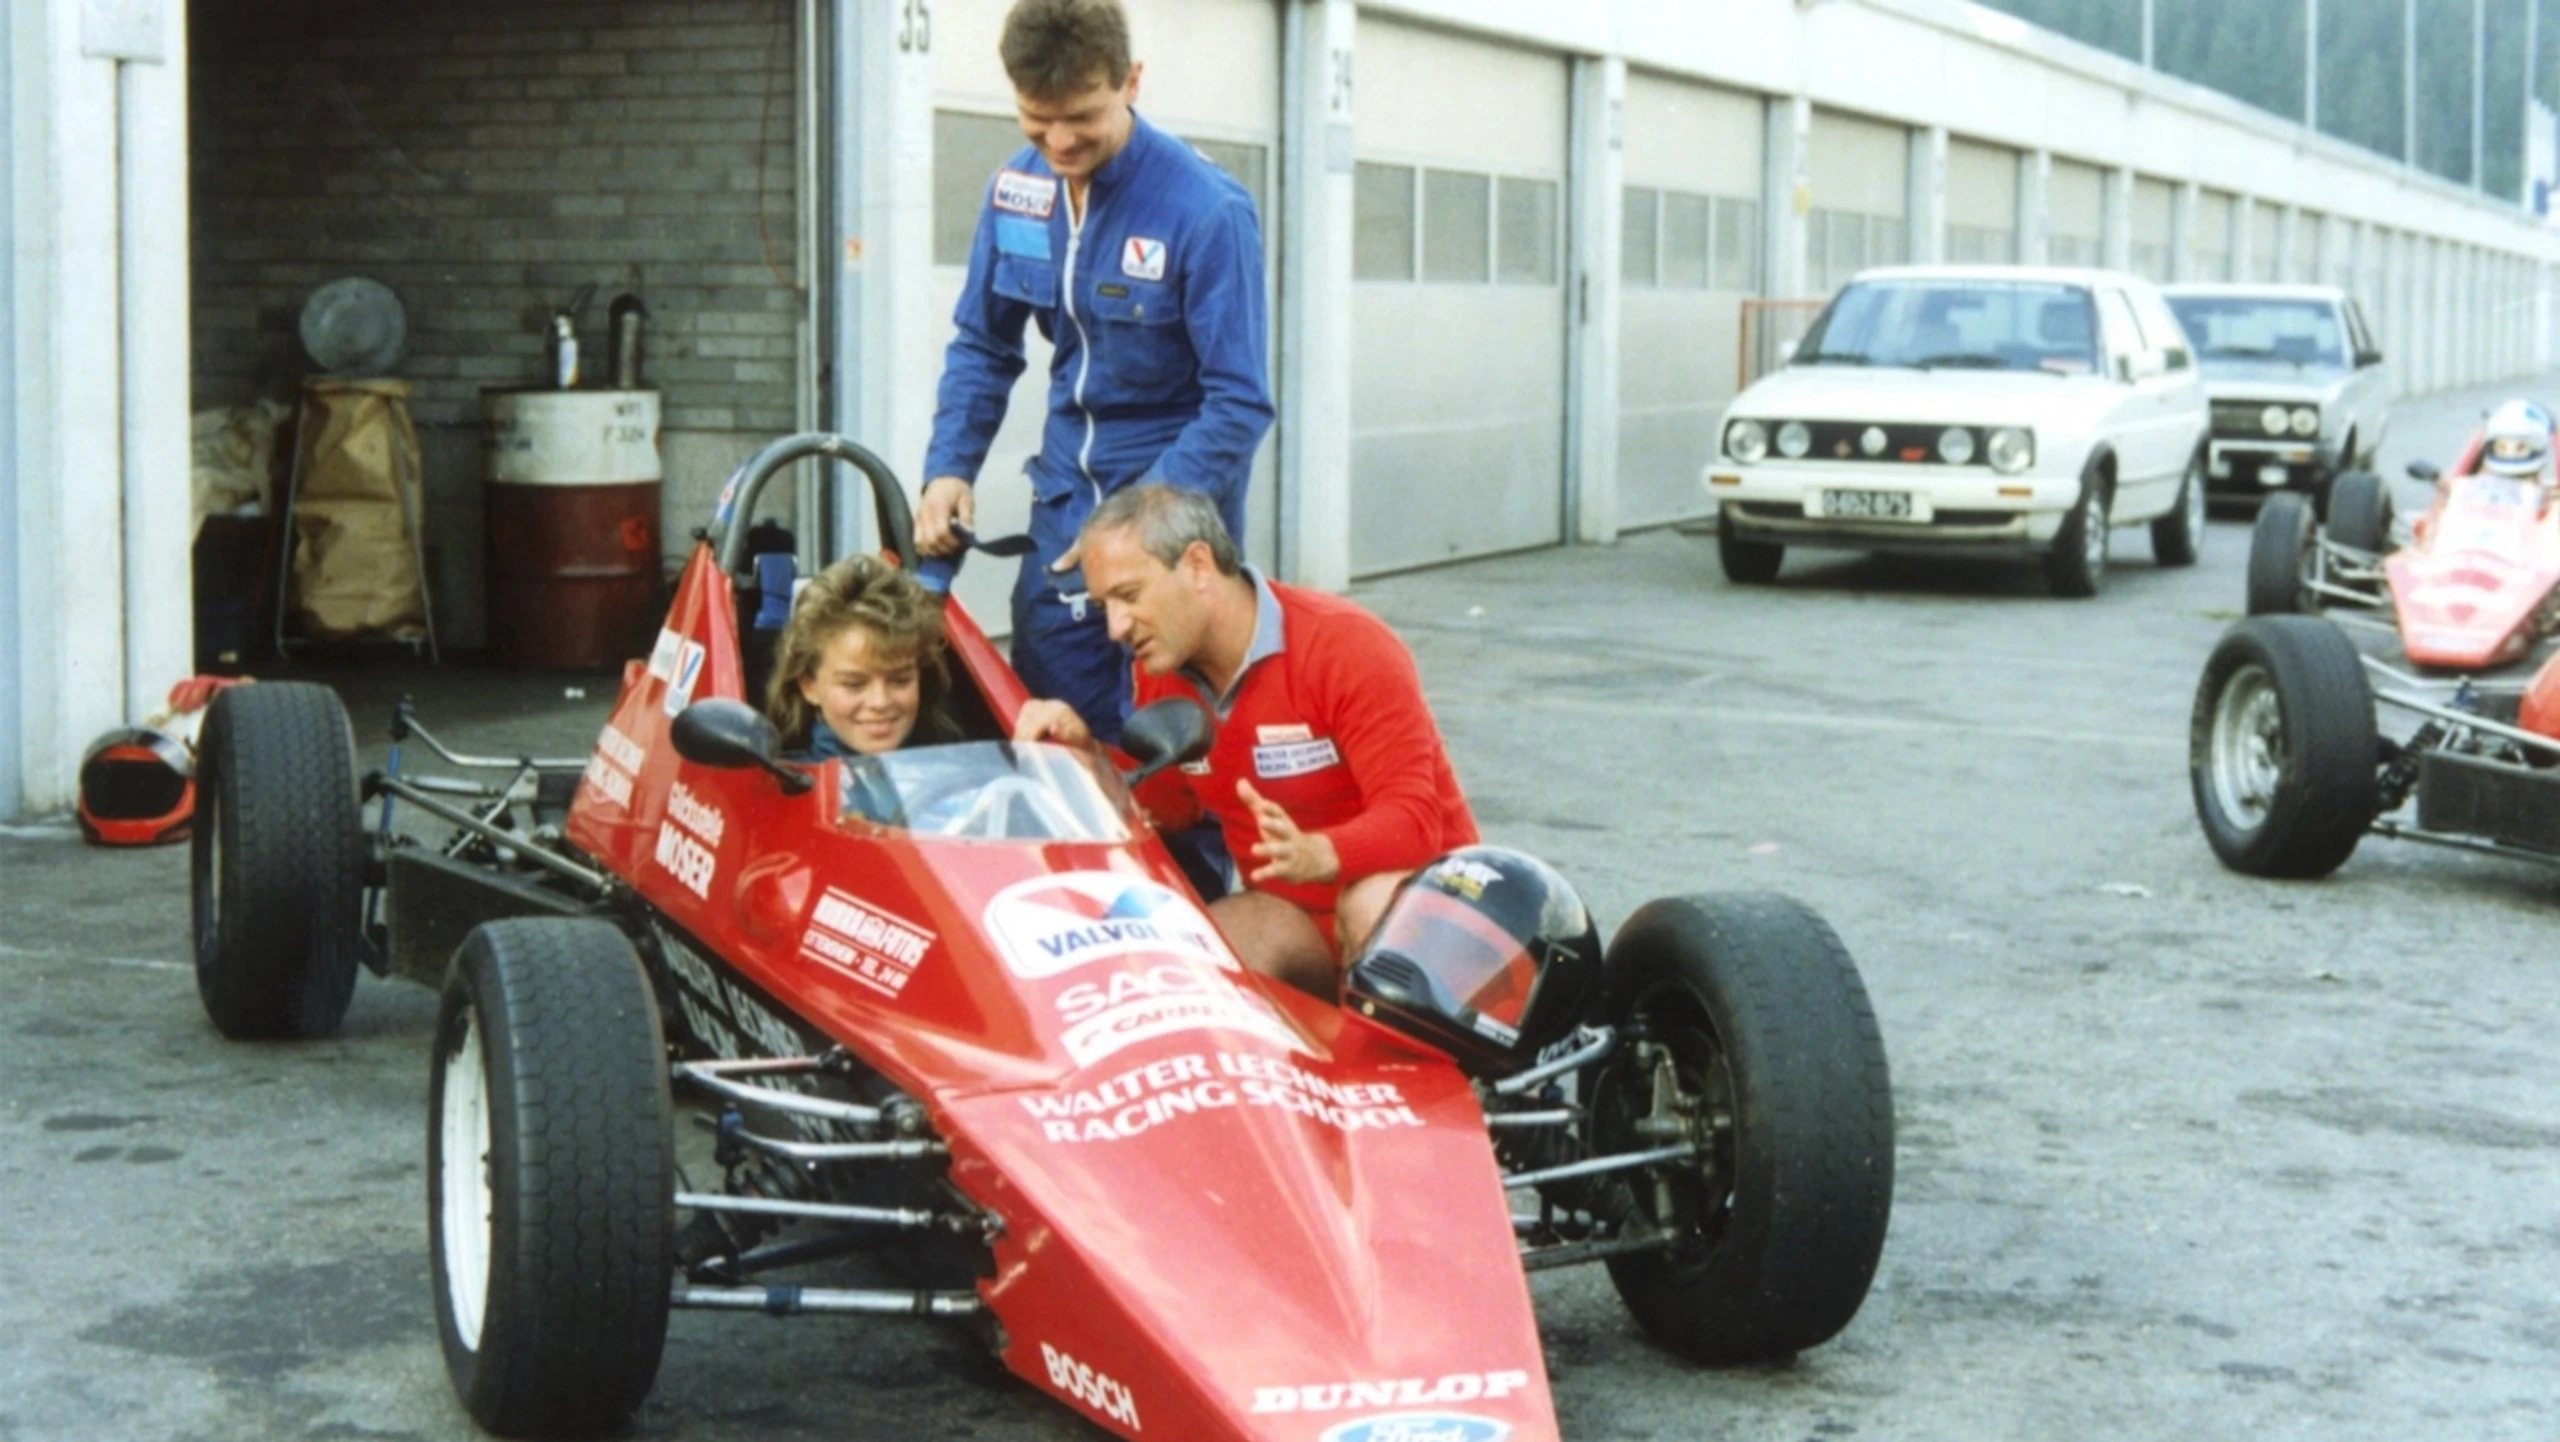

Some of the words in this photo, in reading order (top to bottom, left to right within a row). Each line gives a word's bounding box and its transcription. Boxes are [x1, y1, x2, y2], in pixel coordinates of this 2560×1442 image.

[1017, 1052, 1213, 1122] WALTER
[1216, 1052, 1406, 1109] LECHNER
[1041, 1081, 1239, 1145] RACING
[1241, 1080, 1428, 1132] SCHOOL
[1040, 1341, 1142, 1432] BOSCH
[1250, 1368, 1530, 1415] DUNLOP
